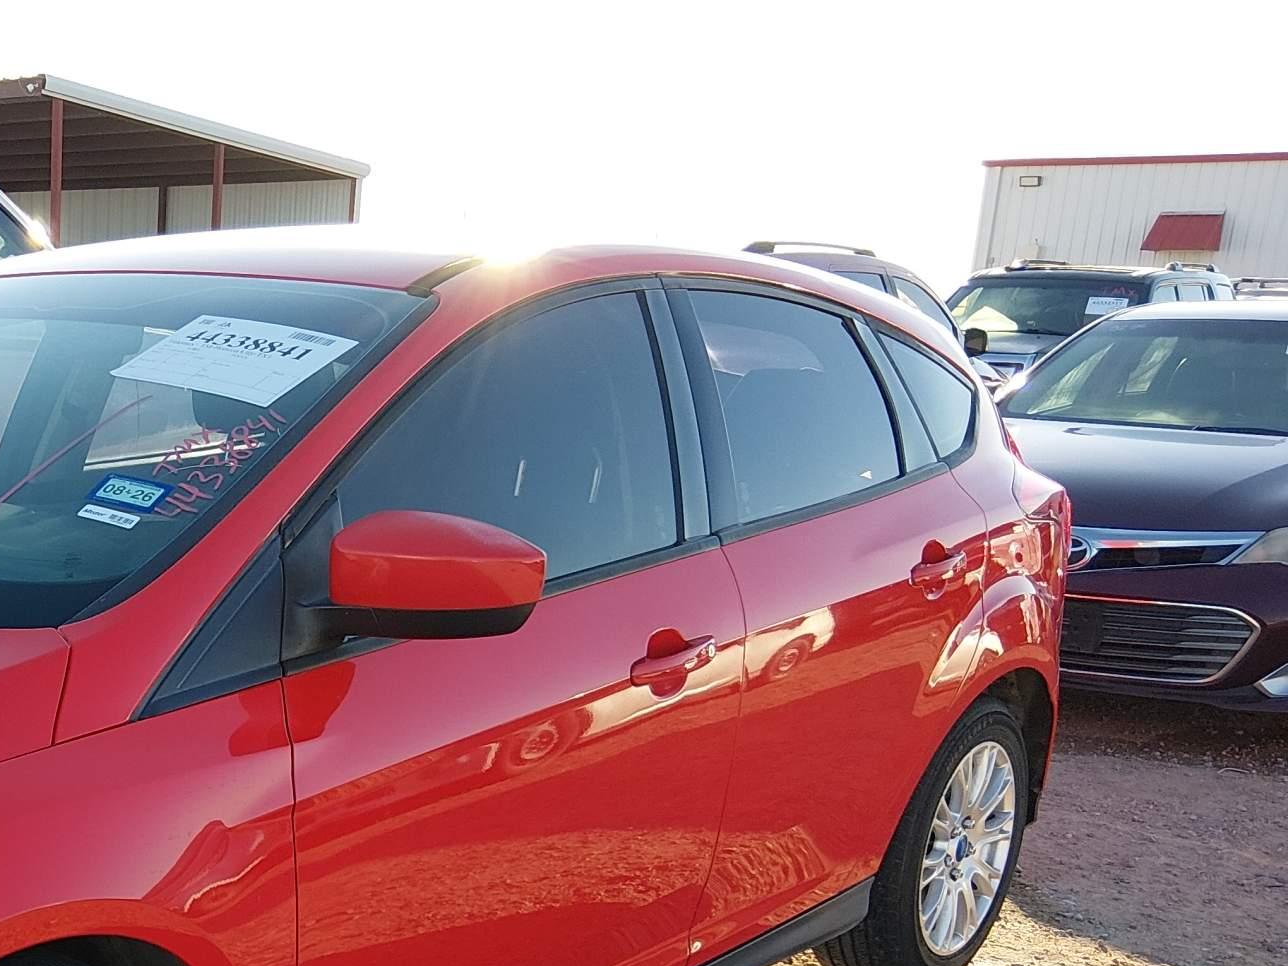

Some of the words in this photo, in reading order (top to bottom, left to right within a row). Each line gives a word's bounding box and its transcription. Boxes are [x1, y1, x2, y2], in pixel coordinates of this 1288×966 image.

[185, 330, 314, 361] 44338841
[103, 484, 126, 496] 08
[130, 489, 156, 502] 26
